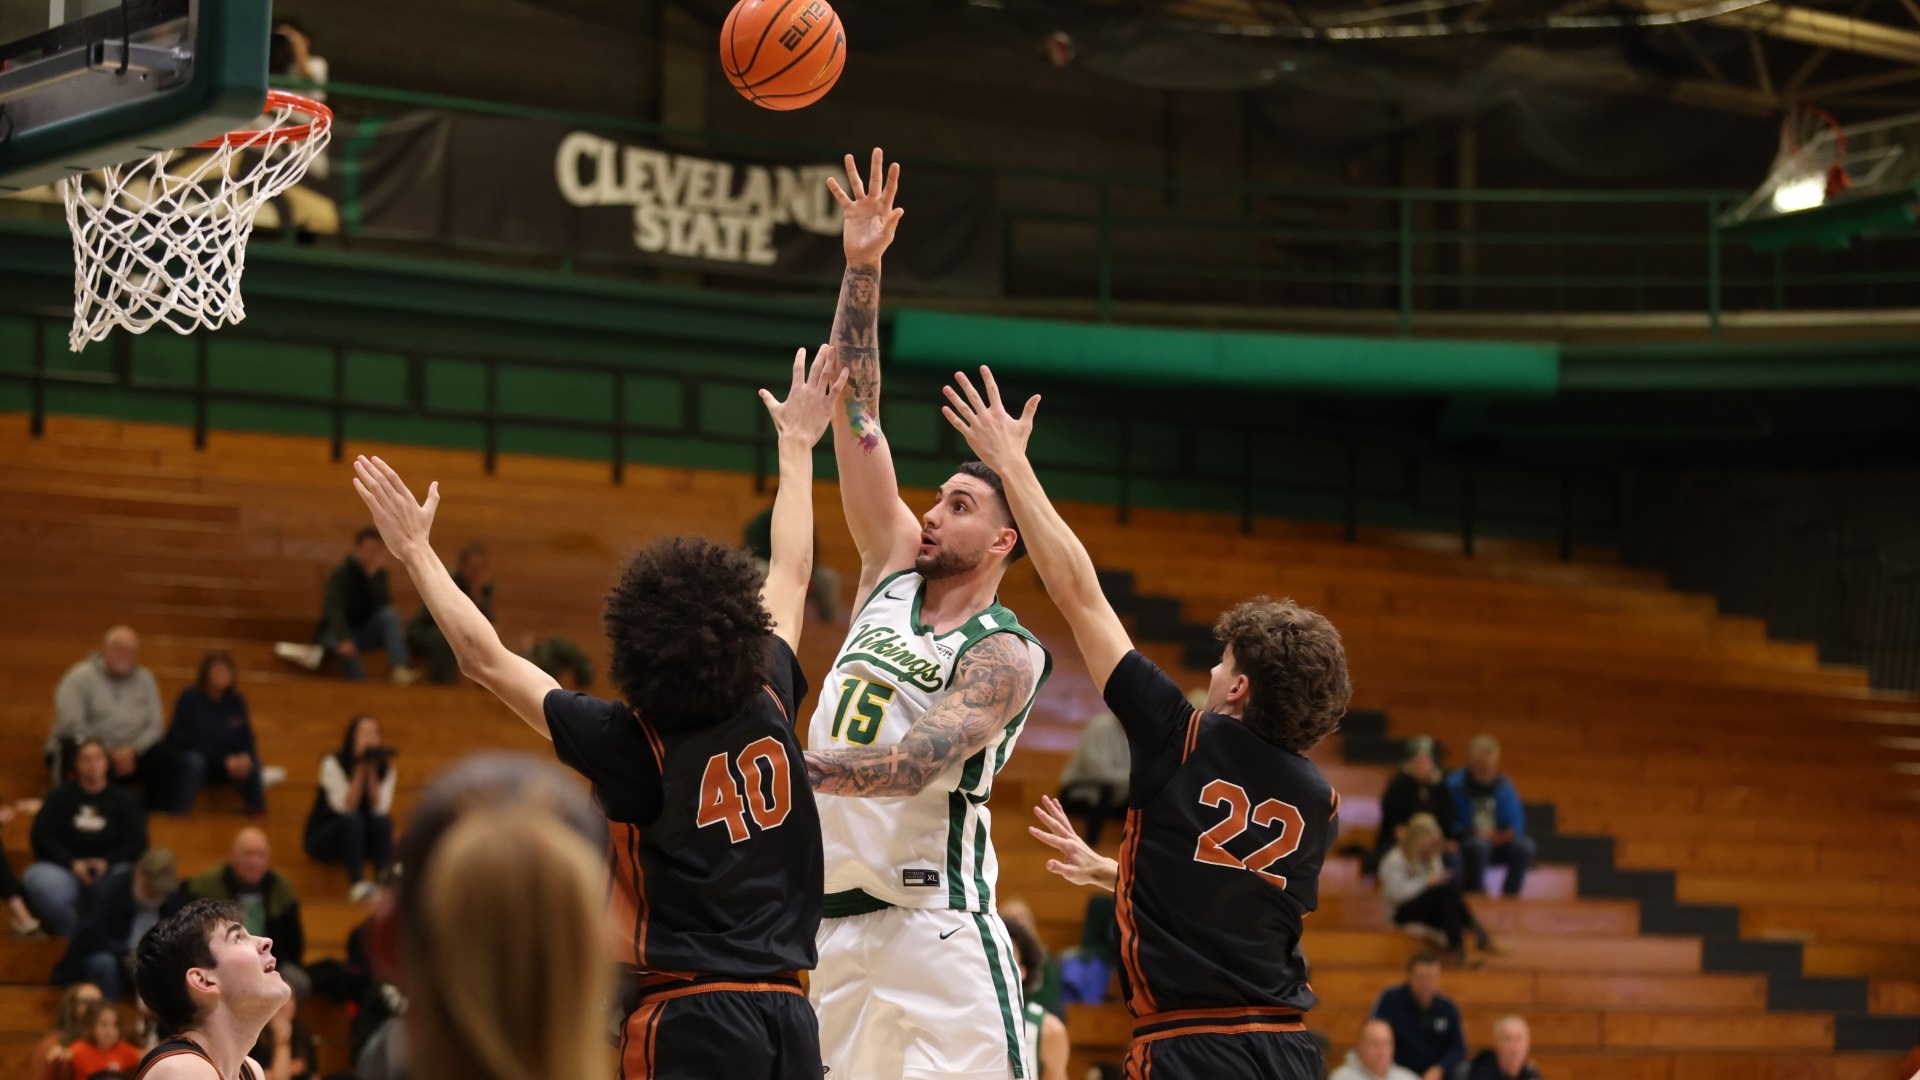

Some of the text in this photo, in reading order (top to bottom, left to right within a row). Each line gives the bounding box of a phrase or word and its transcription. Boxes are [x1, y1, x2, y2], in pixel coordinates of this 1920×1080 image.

[556, 131, 845, 236] CLEVELAND
[634, 206, 777, 265] STATE
[845, 623, 943, 688] Vikings
[831, 678, 894, 746] 15
[695, 735, 792, 844] 40
[1193, 778, 1306, 891] 22
